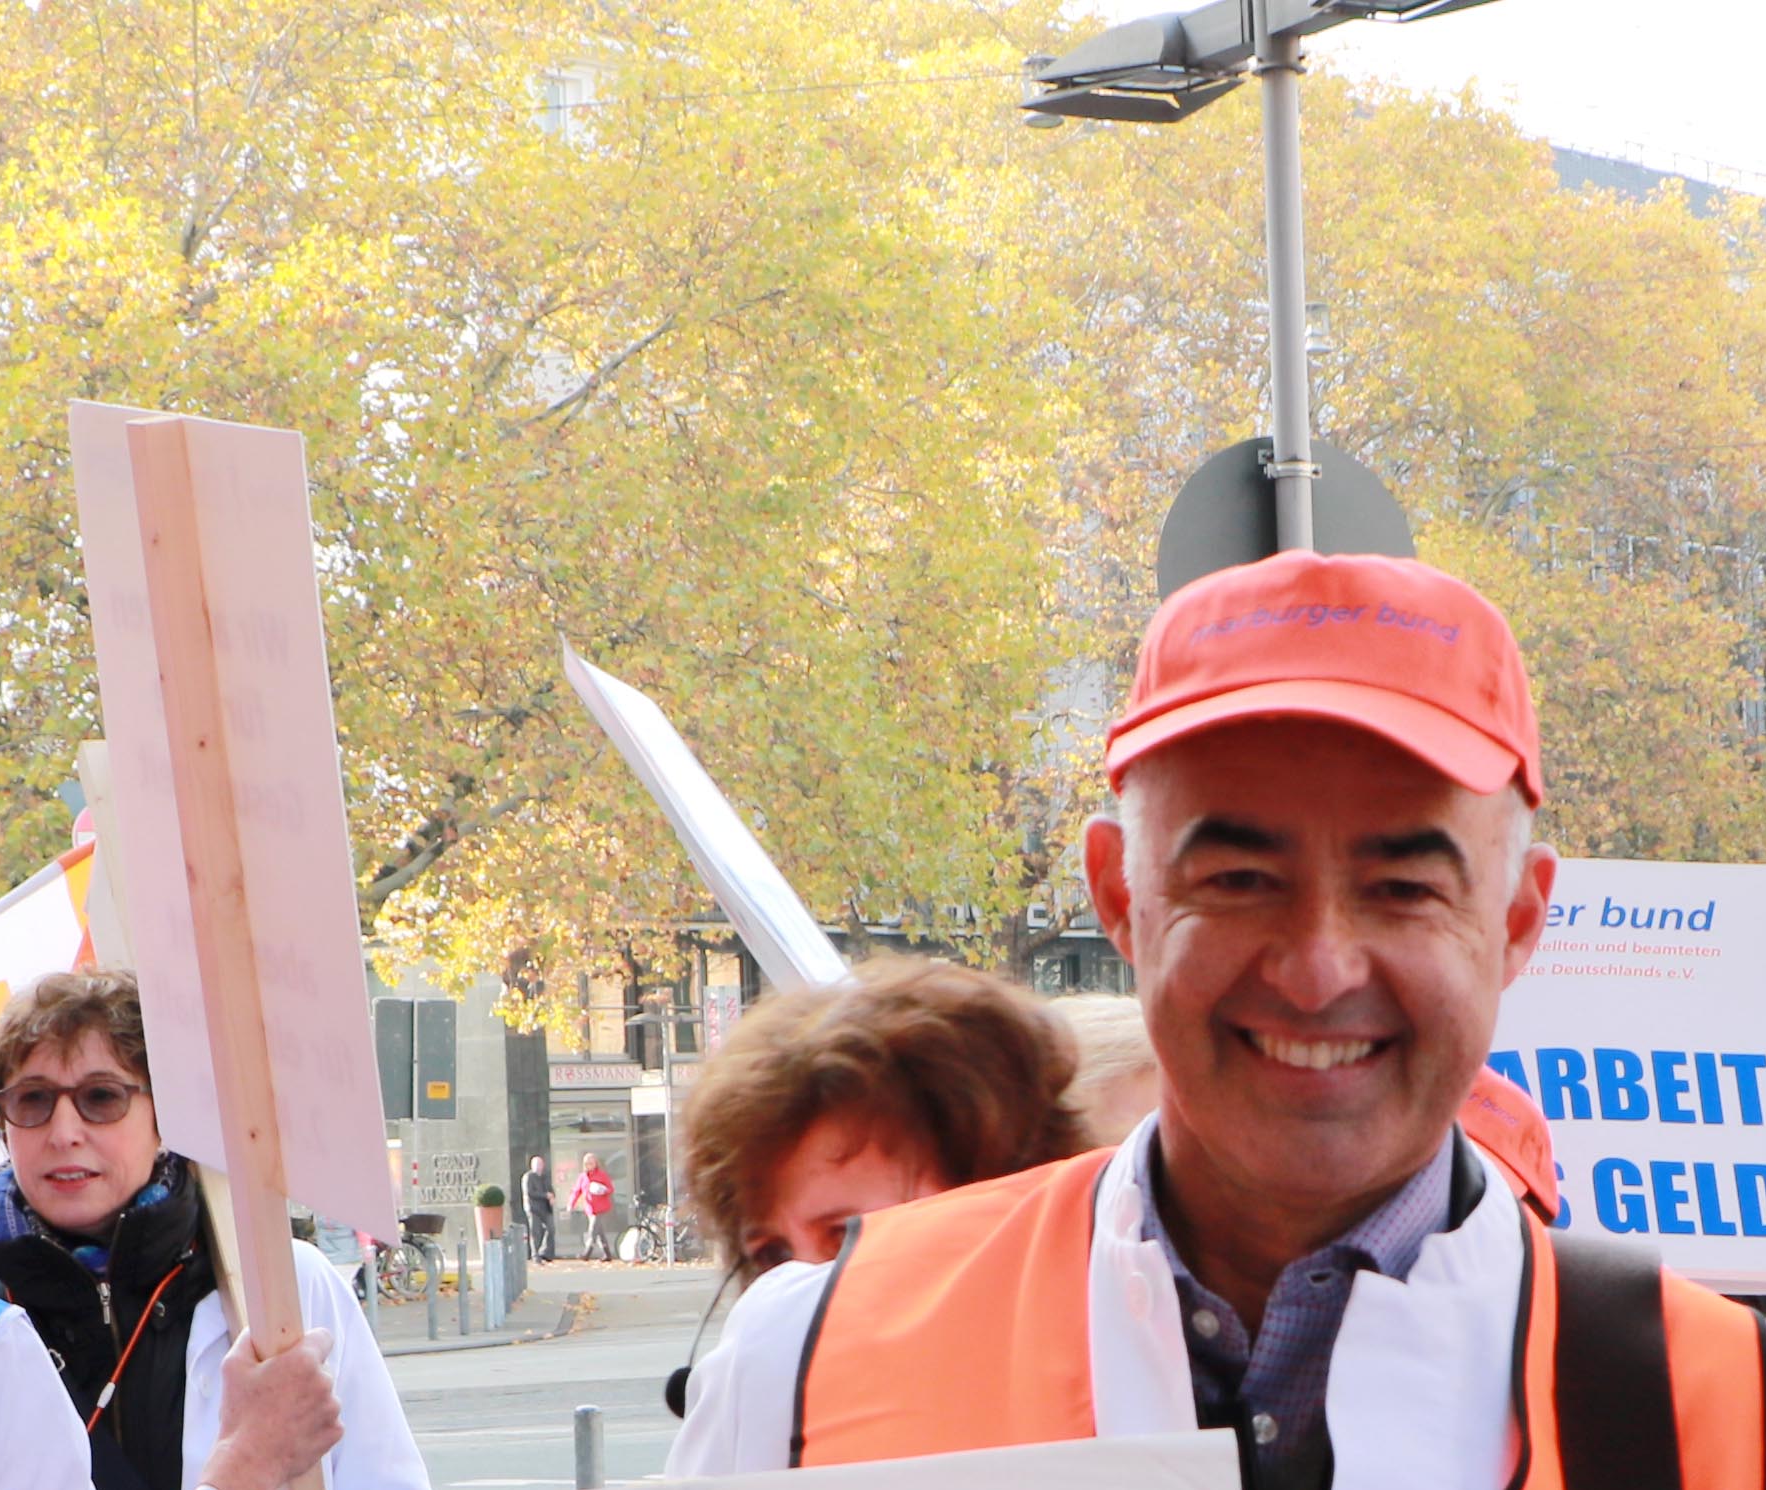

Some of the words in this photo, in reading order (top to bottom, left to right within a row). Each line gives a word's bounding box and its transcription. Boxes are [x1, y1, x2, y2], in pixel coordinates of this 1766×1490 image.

[1189, 601, 1367, 646] marburger
[1375, 601, 1461, 645] bund
[1599, 896, 1716, 932] bund
[1535, 939, 1590, 953] tellten
[1595, 940, 1628, 954] und
[1632, 941, 1722, 958] beamteten
[1552, 963, 1662, 979] Deutschlands
[1667, 967, 1696, 980] e.V.
